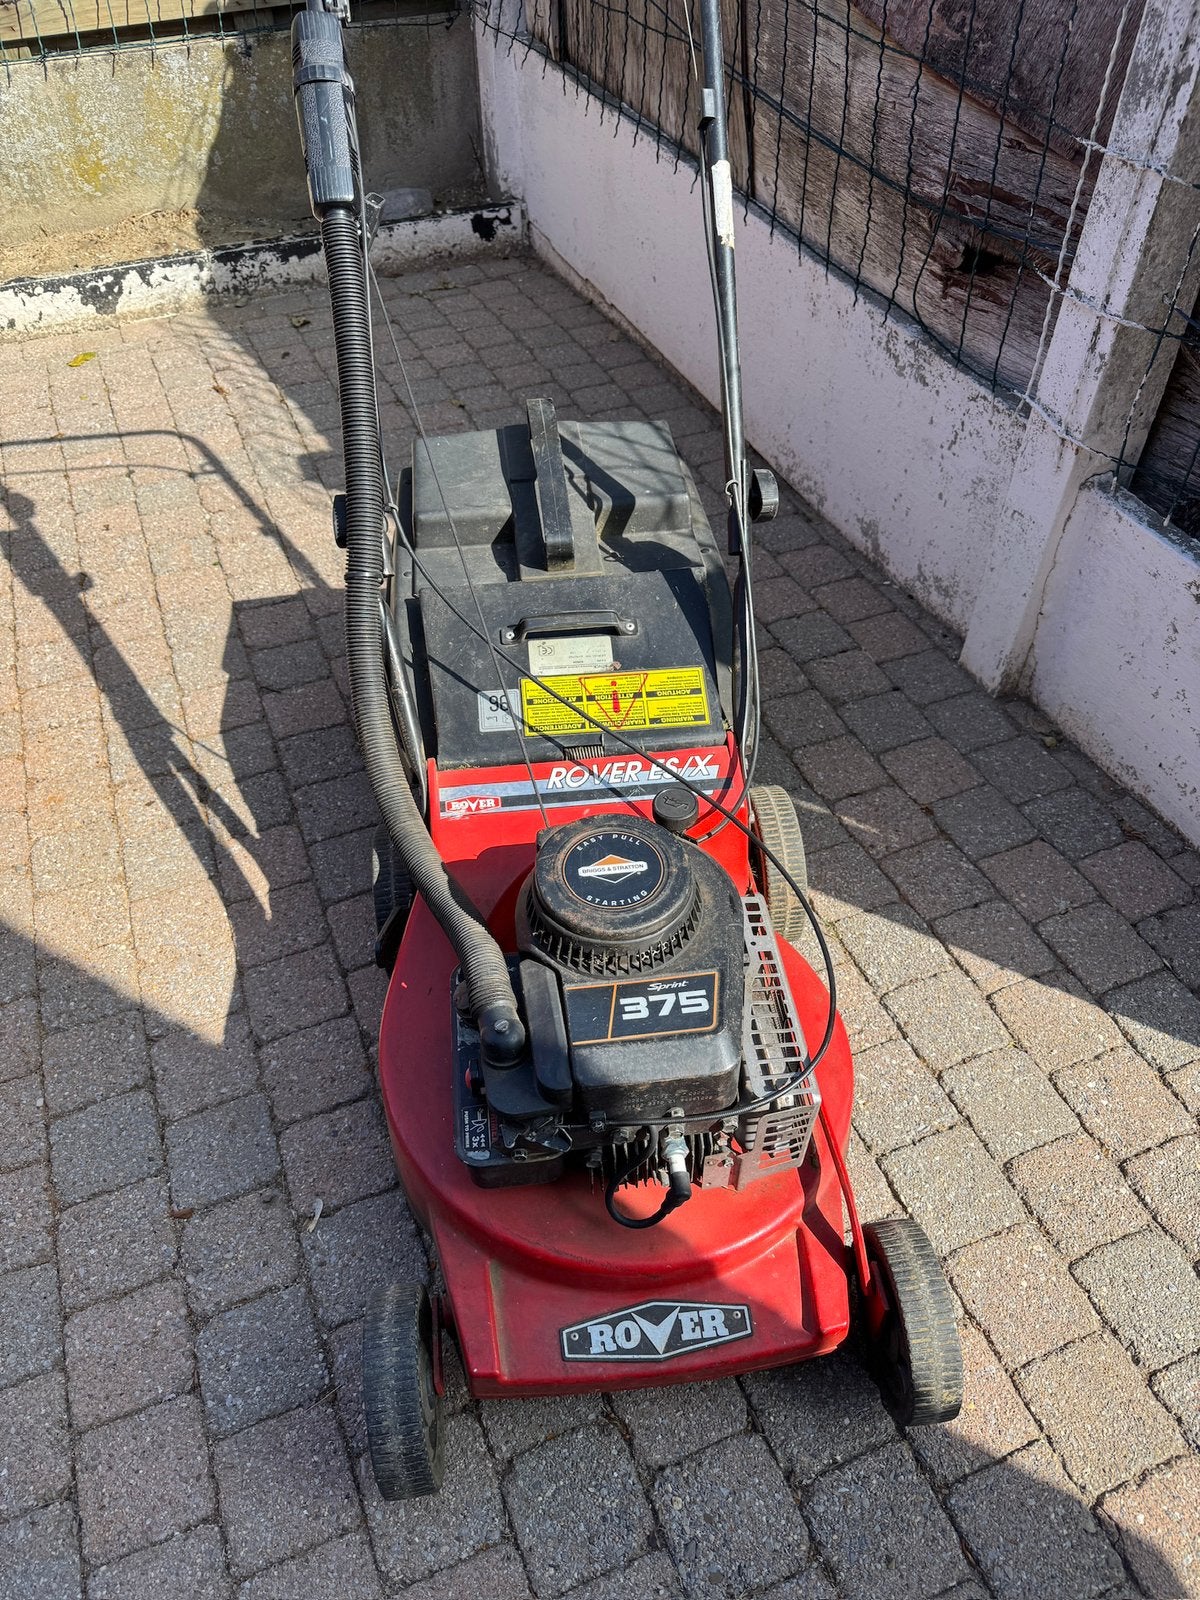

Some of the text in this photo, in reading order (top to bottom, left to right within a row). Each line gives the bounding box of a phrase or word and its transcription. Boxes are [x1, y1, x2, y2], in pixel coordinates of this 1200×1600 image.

[656, 689, 691, 697] ACHTUNG
[660, 715, 695, 723] WARNING
[547, 754, 714, 790] ROVER ES/X
[450, 798, 495, 813] ROVER
[576, 833, 642, 851] EASY PULL
[582, 866, 606, 875] BRIGGS
[612, 863, 644, 872] STRATTON
[586, 889, 648, 906] STARTING
[647, 980, 689, 991] Sprint
[619, 989, 710, 1021] 375
[588, 1307, 729, 1355] ROVER
